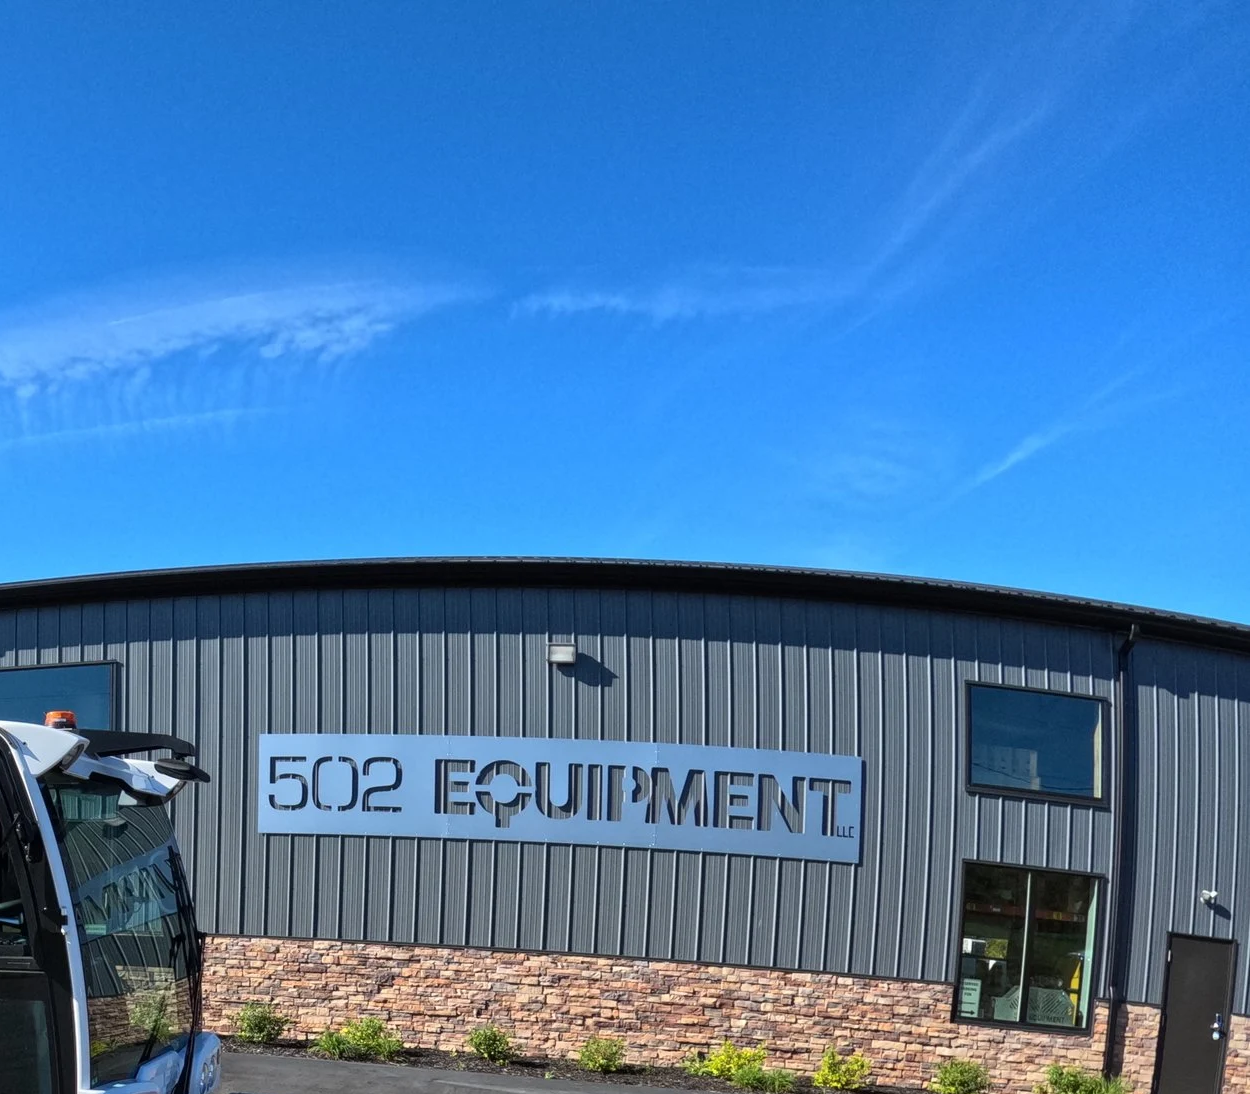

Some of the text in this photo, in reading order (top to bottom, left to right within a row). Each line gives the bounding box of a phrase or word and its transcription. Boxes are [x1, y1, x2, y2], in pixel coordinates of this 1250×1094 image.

[268, 755, 853, 838] 502 EQUIPMENT
[836, 825, 855, 839] LLC
